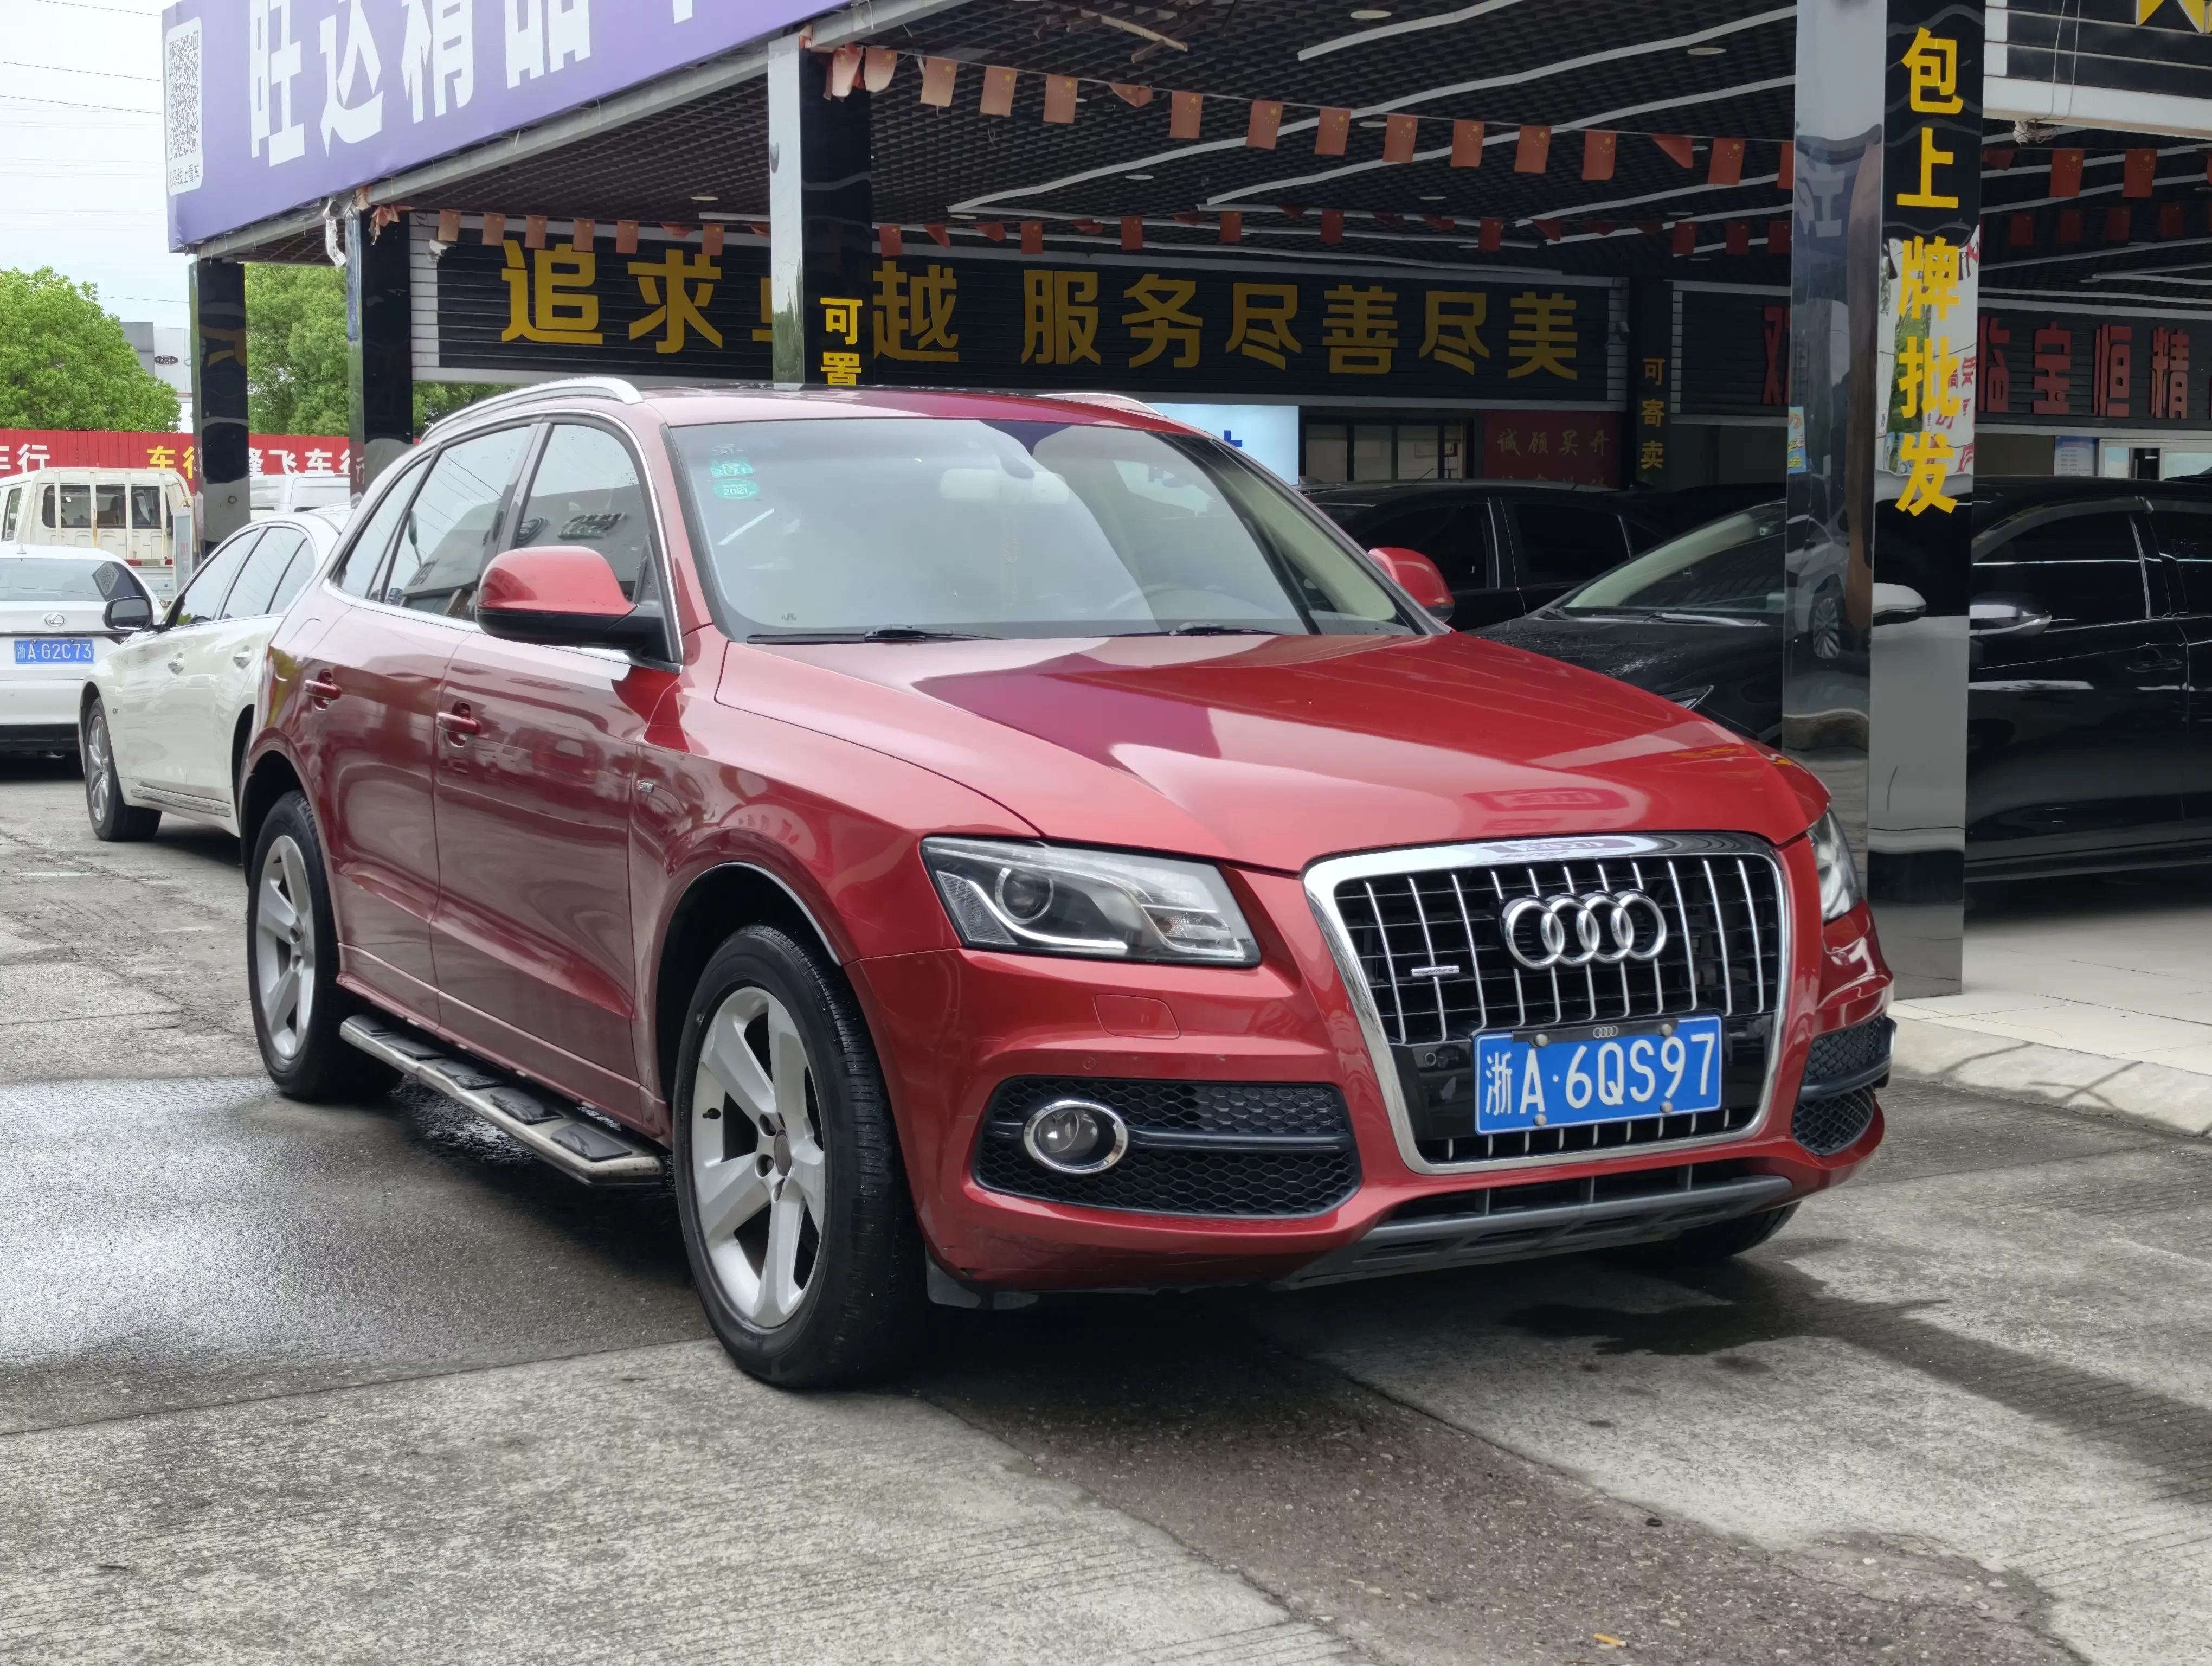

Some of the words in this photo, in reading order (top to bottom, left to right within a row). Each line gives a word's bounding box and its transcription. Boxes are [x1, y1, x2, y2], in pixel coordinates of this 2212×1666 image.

[501, 239, 959, 362] 追求越
[1021, 269, 1578, 380] 服务尽善尽美
[1895, 27, 1963, 516] 包上牌批发
[1641, 358, 1665, 469] 可寄卖
[723, 488, 748, 496] 2021
